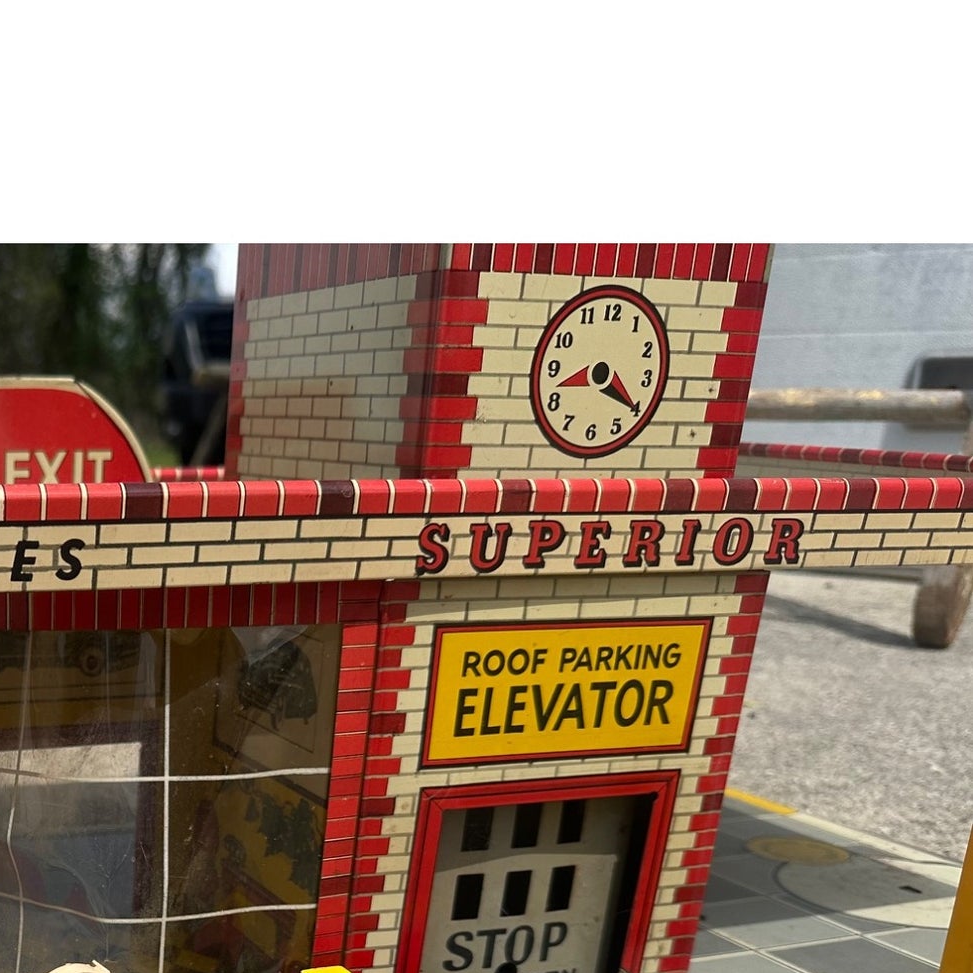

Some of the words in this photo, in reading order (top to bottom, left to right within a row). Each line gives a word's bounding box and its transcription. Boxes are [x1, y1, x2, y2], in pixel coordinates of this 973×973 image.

[580, 307, 595, 324] 11
[603, 303, 622, 322] 12
[631, 315, 640, 333] 1
[554, 331, 573, 349] 10
[641, 341, 653, 358] 2
[547, 359, 561, 377] 9
[640, 369, 653, 387] 3
[547, 392, 561, 412] 8
[630, 400, 641, 418] 4
[562, 414, 575, 431] 7
[610, 417, 622, 435] 5
[585, 424, 597, 441] 6
[5, 451, 112, 484] EXIT
[415, 517, 804, 576] SUPERIOR
[460, 648, 548, 678] ROOF
[557, 642, 682, 673] PARKING
[452, 678, 674, 737] ELEVATOR
[442, 921, 568, 972] STOP
